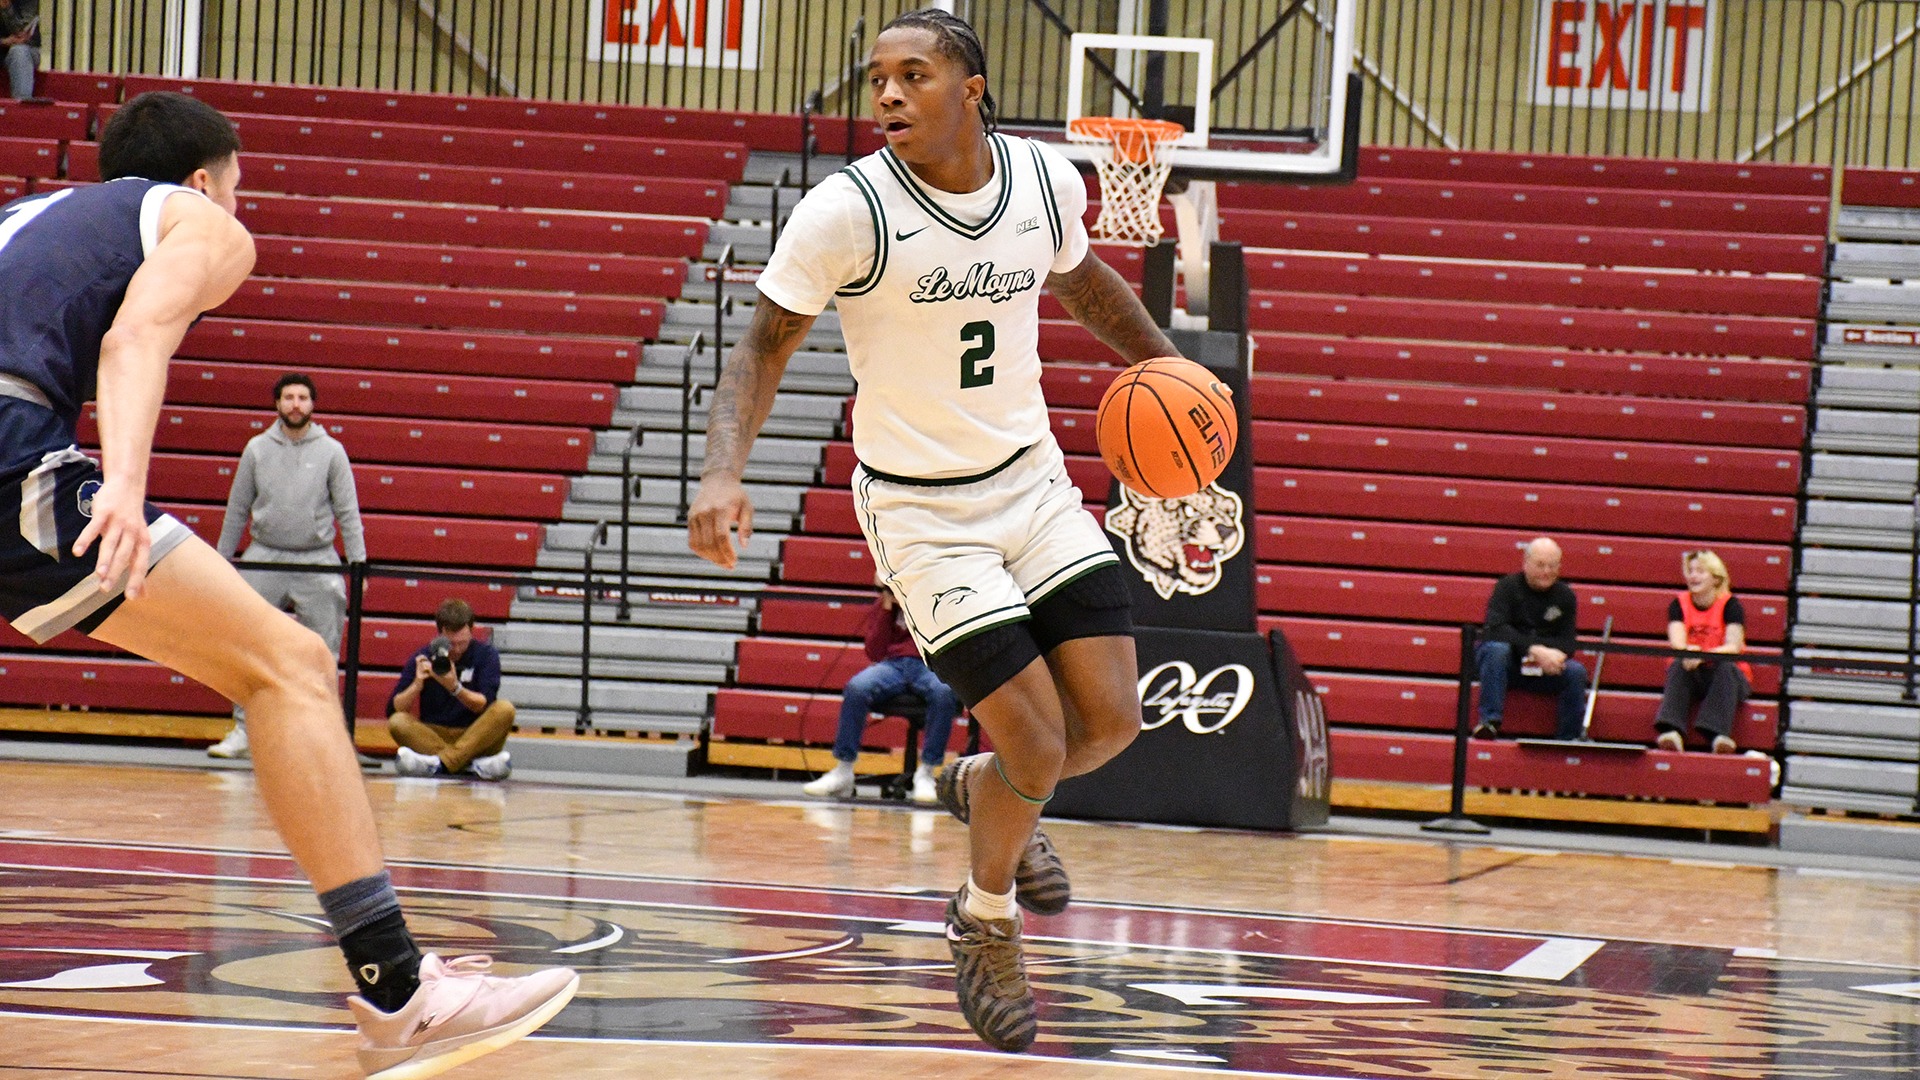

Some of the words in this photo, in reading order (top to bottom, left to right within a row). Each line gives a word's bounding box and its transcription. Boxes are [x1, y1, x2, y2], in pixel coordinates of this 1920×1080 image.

[1546, 1, 1706, 93] EXIT
[1016, 216, 1038, 234] NEC
[909, 266, 953, 303] Le
[953, 261, 1035, 303] Moyne
[960, 319, 995, 389] 2
[1188, 403, 1226, 470] ELITE
